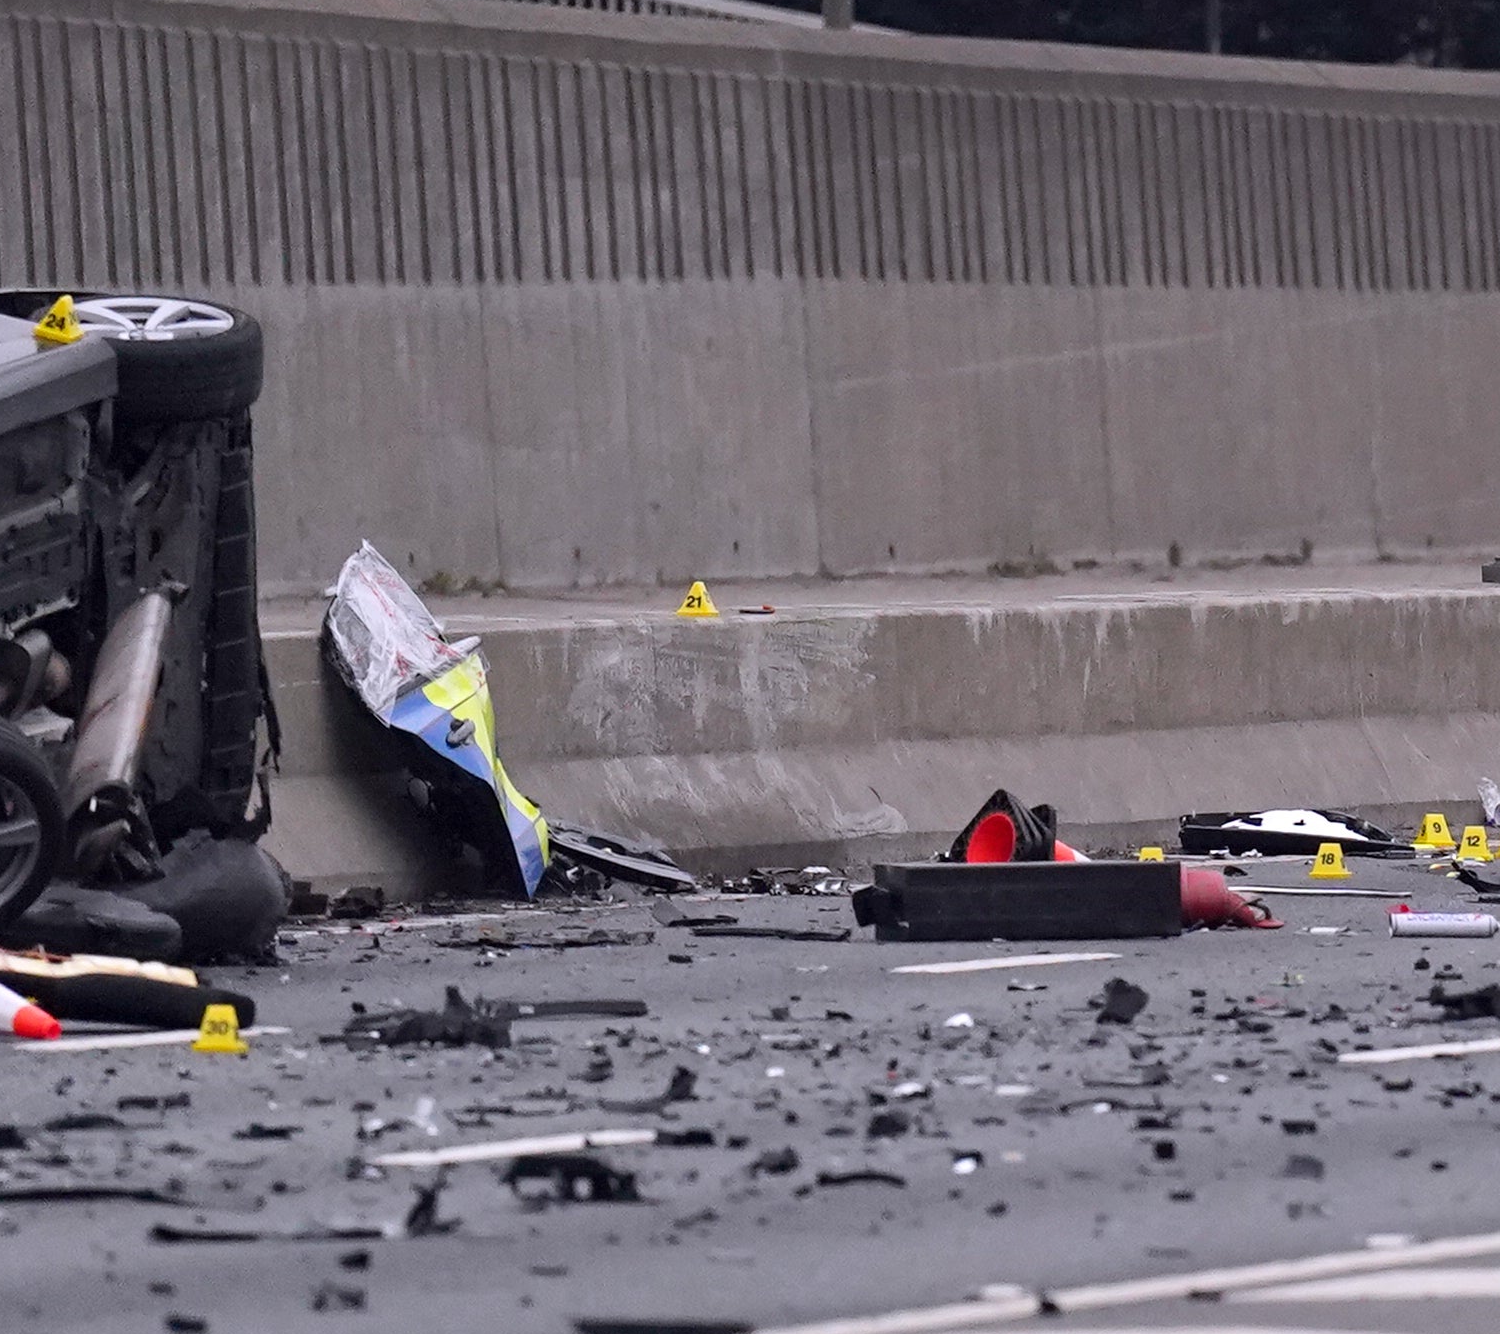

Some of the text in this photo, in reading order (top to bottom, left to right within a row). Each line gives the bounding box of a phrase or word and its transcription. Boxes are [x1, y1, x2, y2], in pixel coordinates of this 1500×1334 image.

[685, 595, 702, 609] 21
[1432, 822, 1442, 834] 9
[1465, 835, 1481, 847] 12
[1321, 853, 1336, 866] 18
